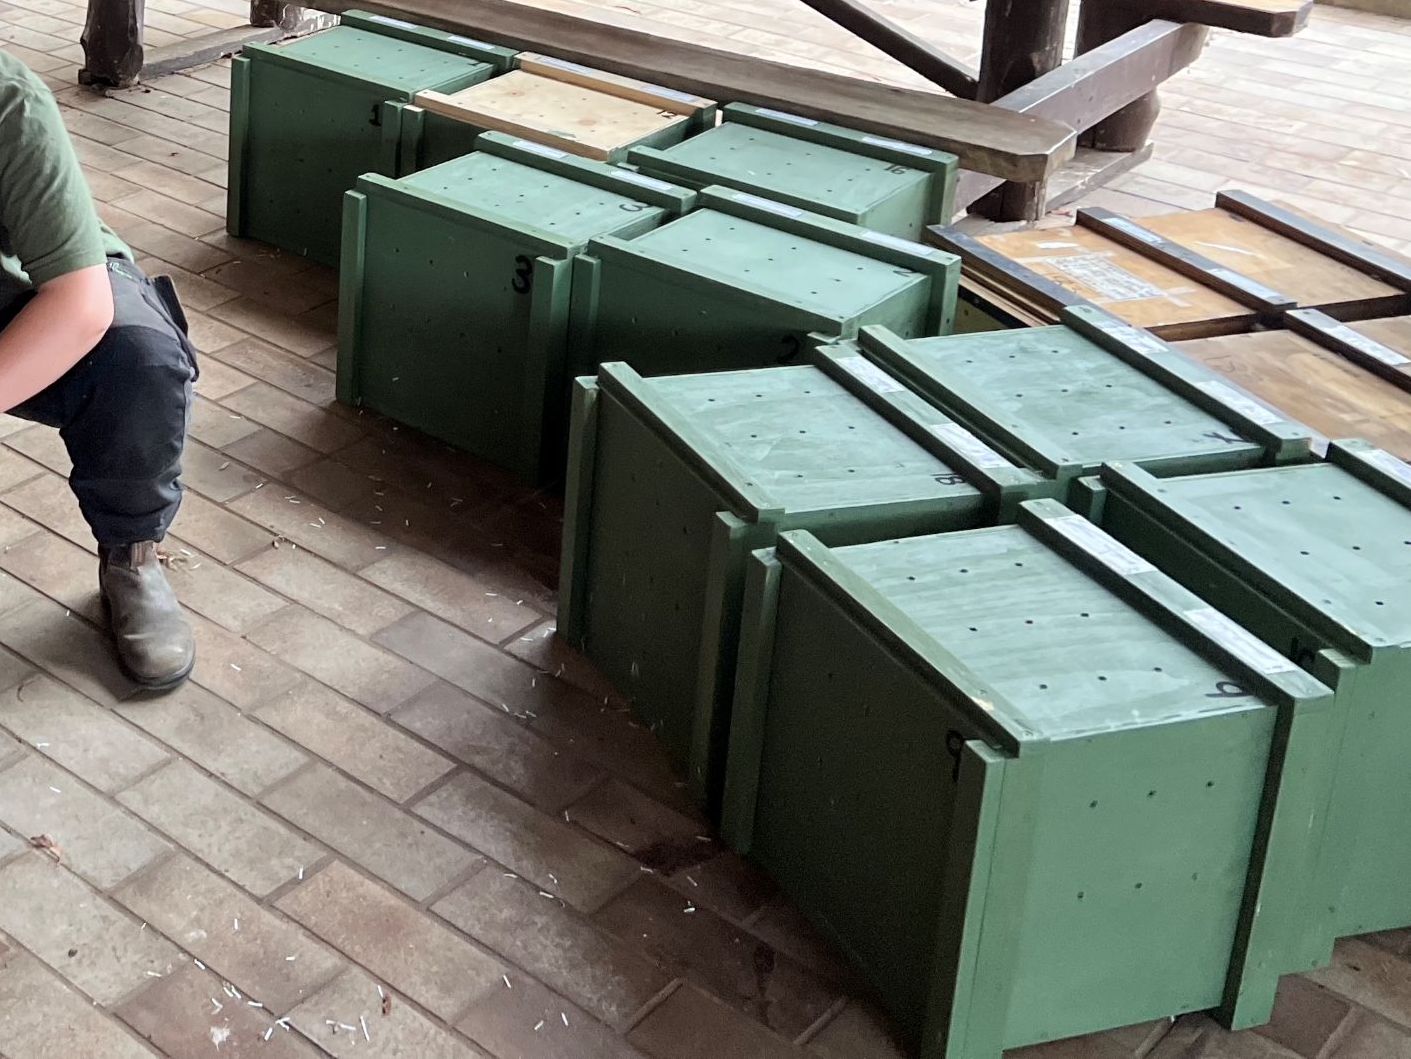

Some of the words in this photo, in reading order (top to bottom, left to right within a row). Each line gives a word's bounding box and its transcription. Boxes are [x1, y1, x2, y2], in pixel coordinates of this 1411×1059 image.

[883, 163, 910, 175] 16
[511, 254, 533, 294] 3
[930, 472, 965, 486] 18
[946, 728, 965, 783] 9
